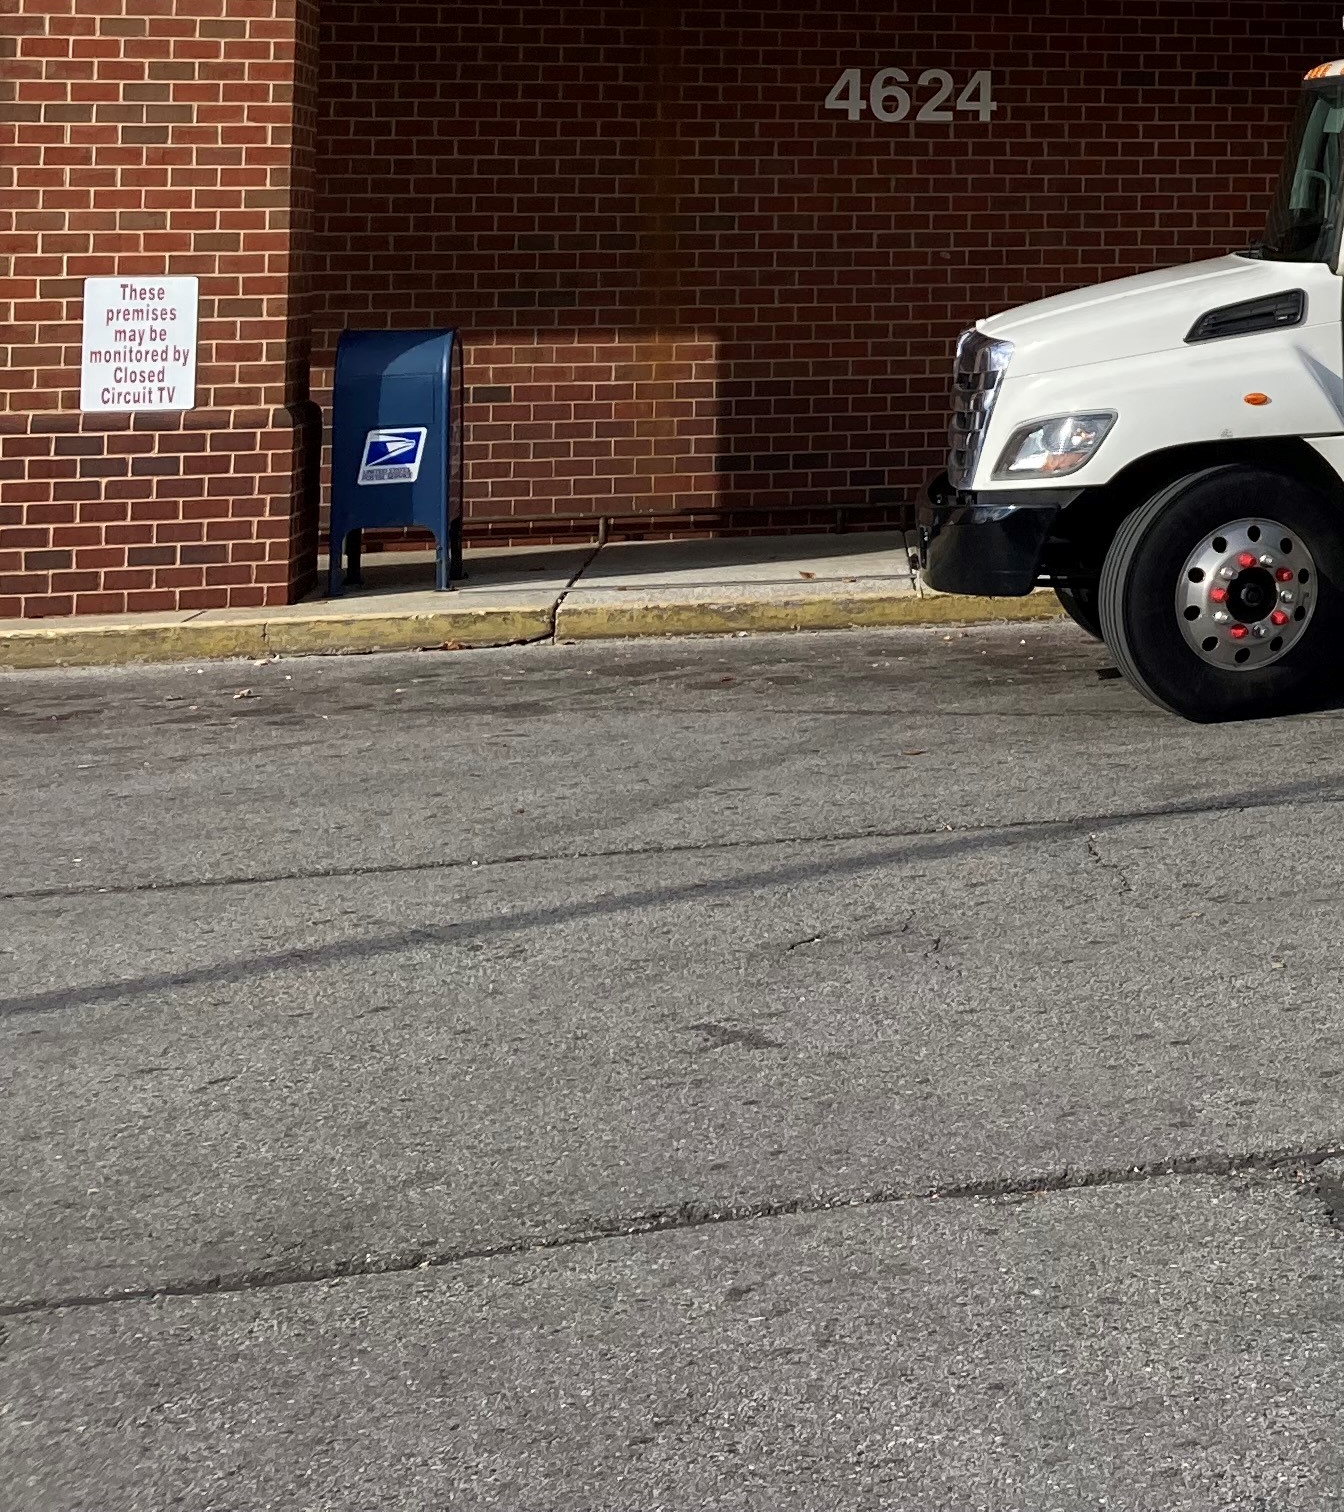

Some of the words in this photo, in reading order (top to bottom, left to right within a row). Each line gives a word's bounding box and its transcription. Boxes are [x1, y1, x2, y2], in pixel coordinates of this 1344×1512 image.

[824, 67, 998, 123] 4624
[120, 283, 166, 301] These
[105, 303, 178, 327] premises
[114, 328, 145, 347] may
[149, 324, 168, 342] be
[89, 345, 169, 364] monitored
[173, 344, 190, 366] by
[113, 366, 166, 384] Closed
[101, 386, 153, 405] Circuit
[157, 385, 177, 404] TV
